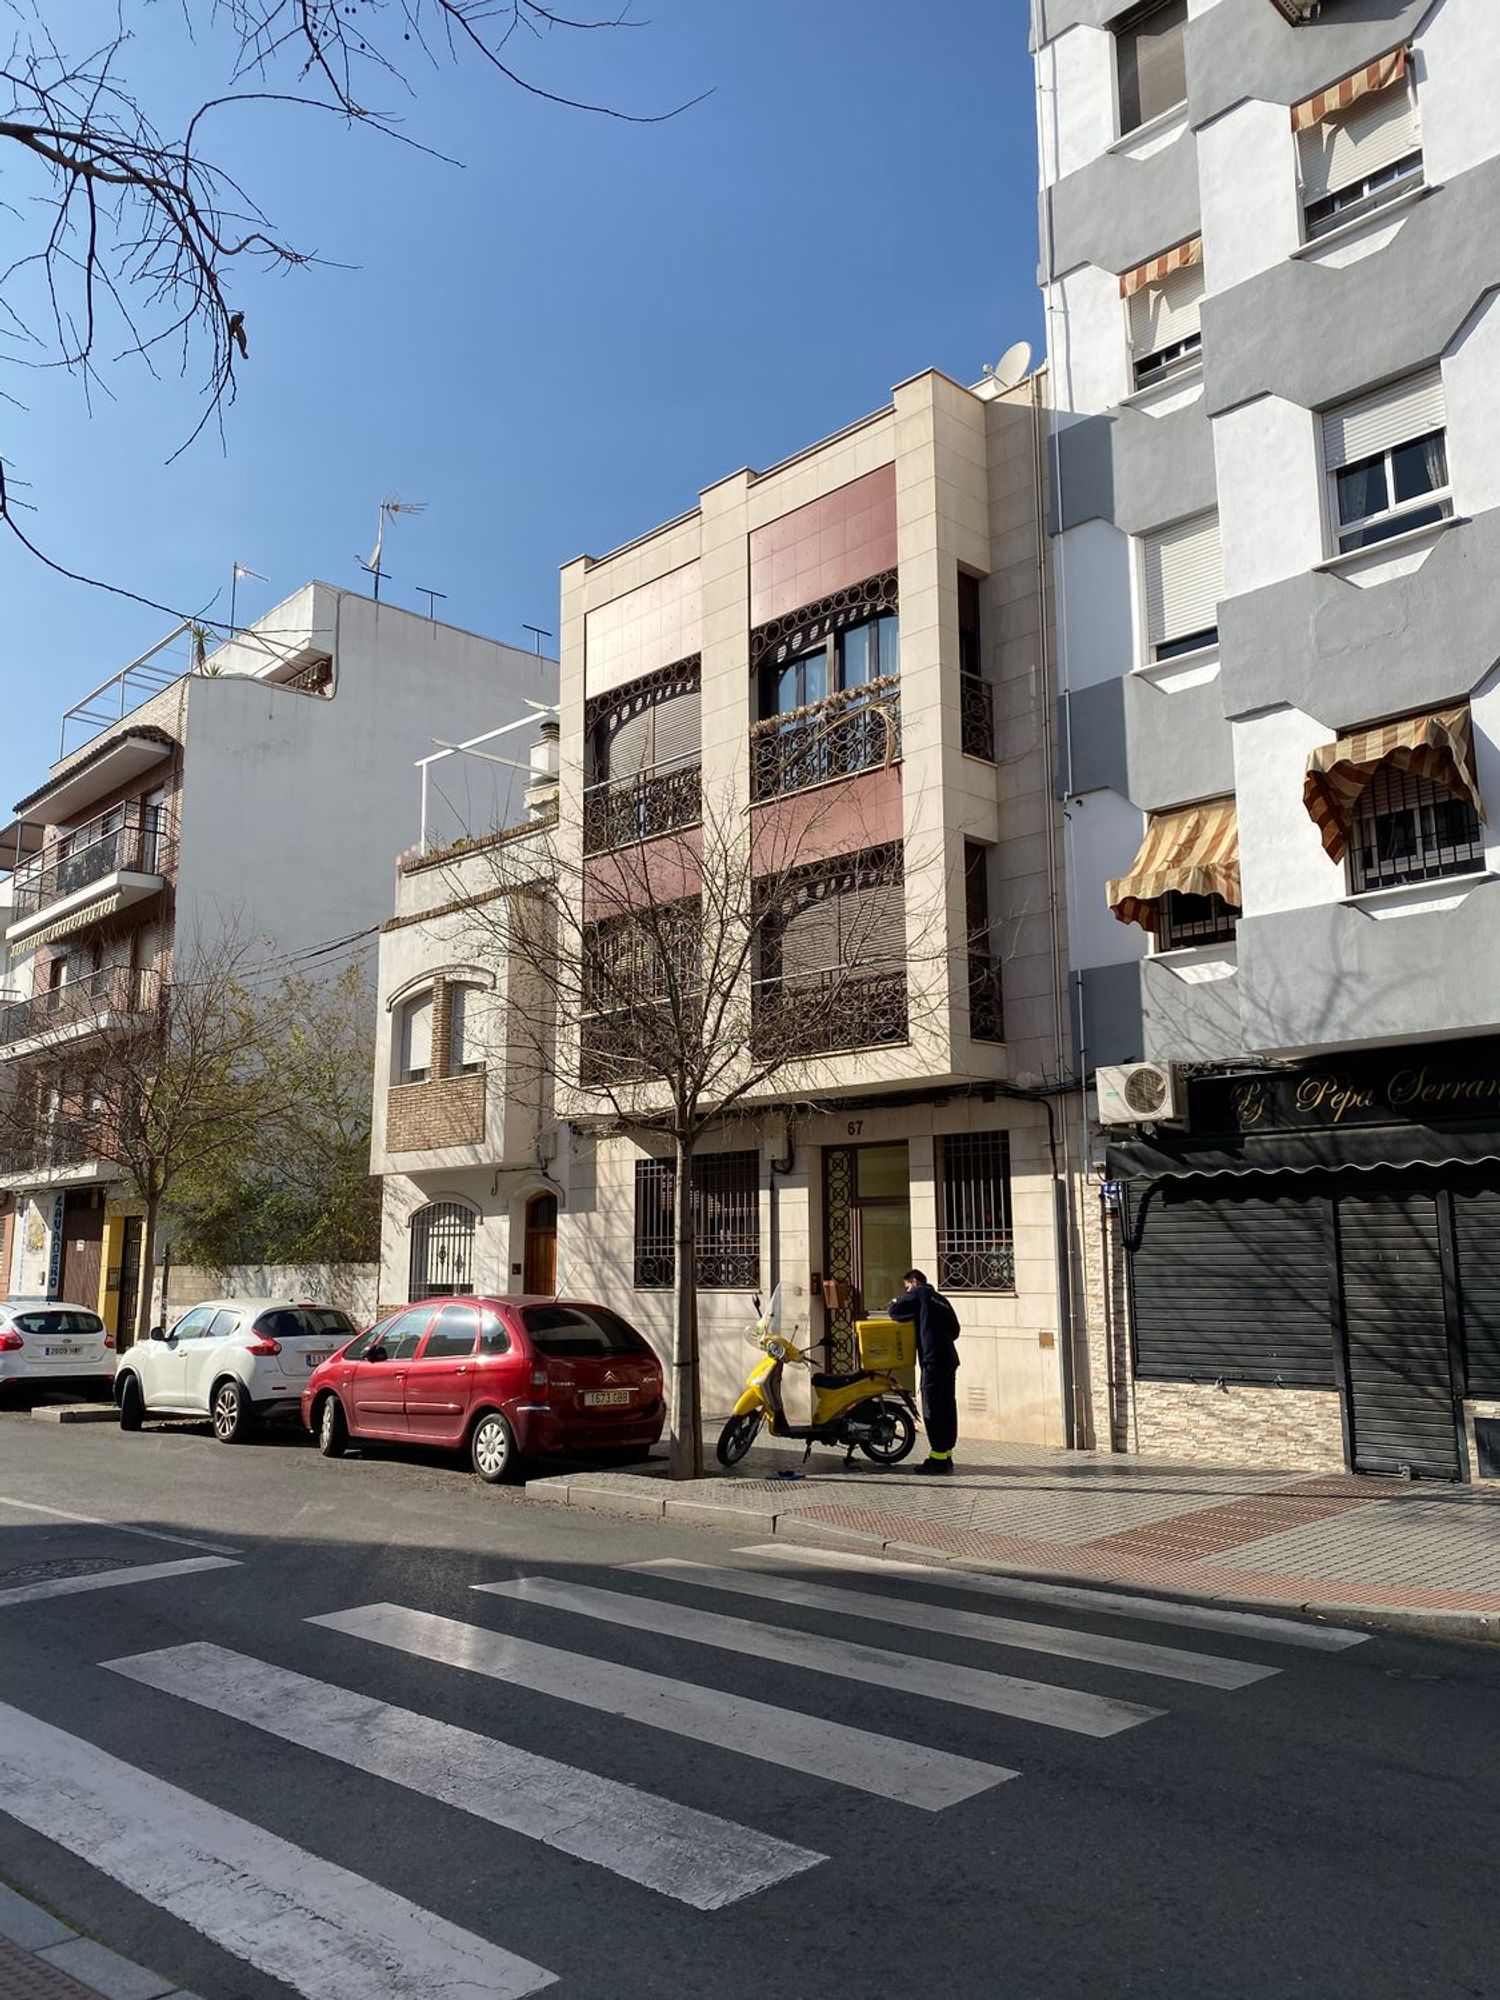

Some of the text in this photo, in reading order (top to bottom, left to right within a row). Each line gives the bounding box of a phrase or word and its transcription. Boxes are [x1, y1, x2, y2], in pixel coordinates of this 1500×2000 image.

[1296, 1076, 1373, 1122] Pepa
[847, 1120, 864, 1136] 67
[49, 1195, 63, 1289] LAVADERO
